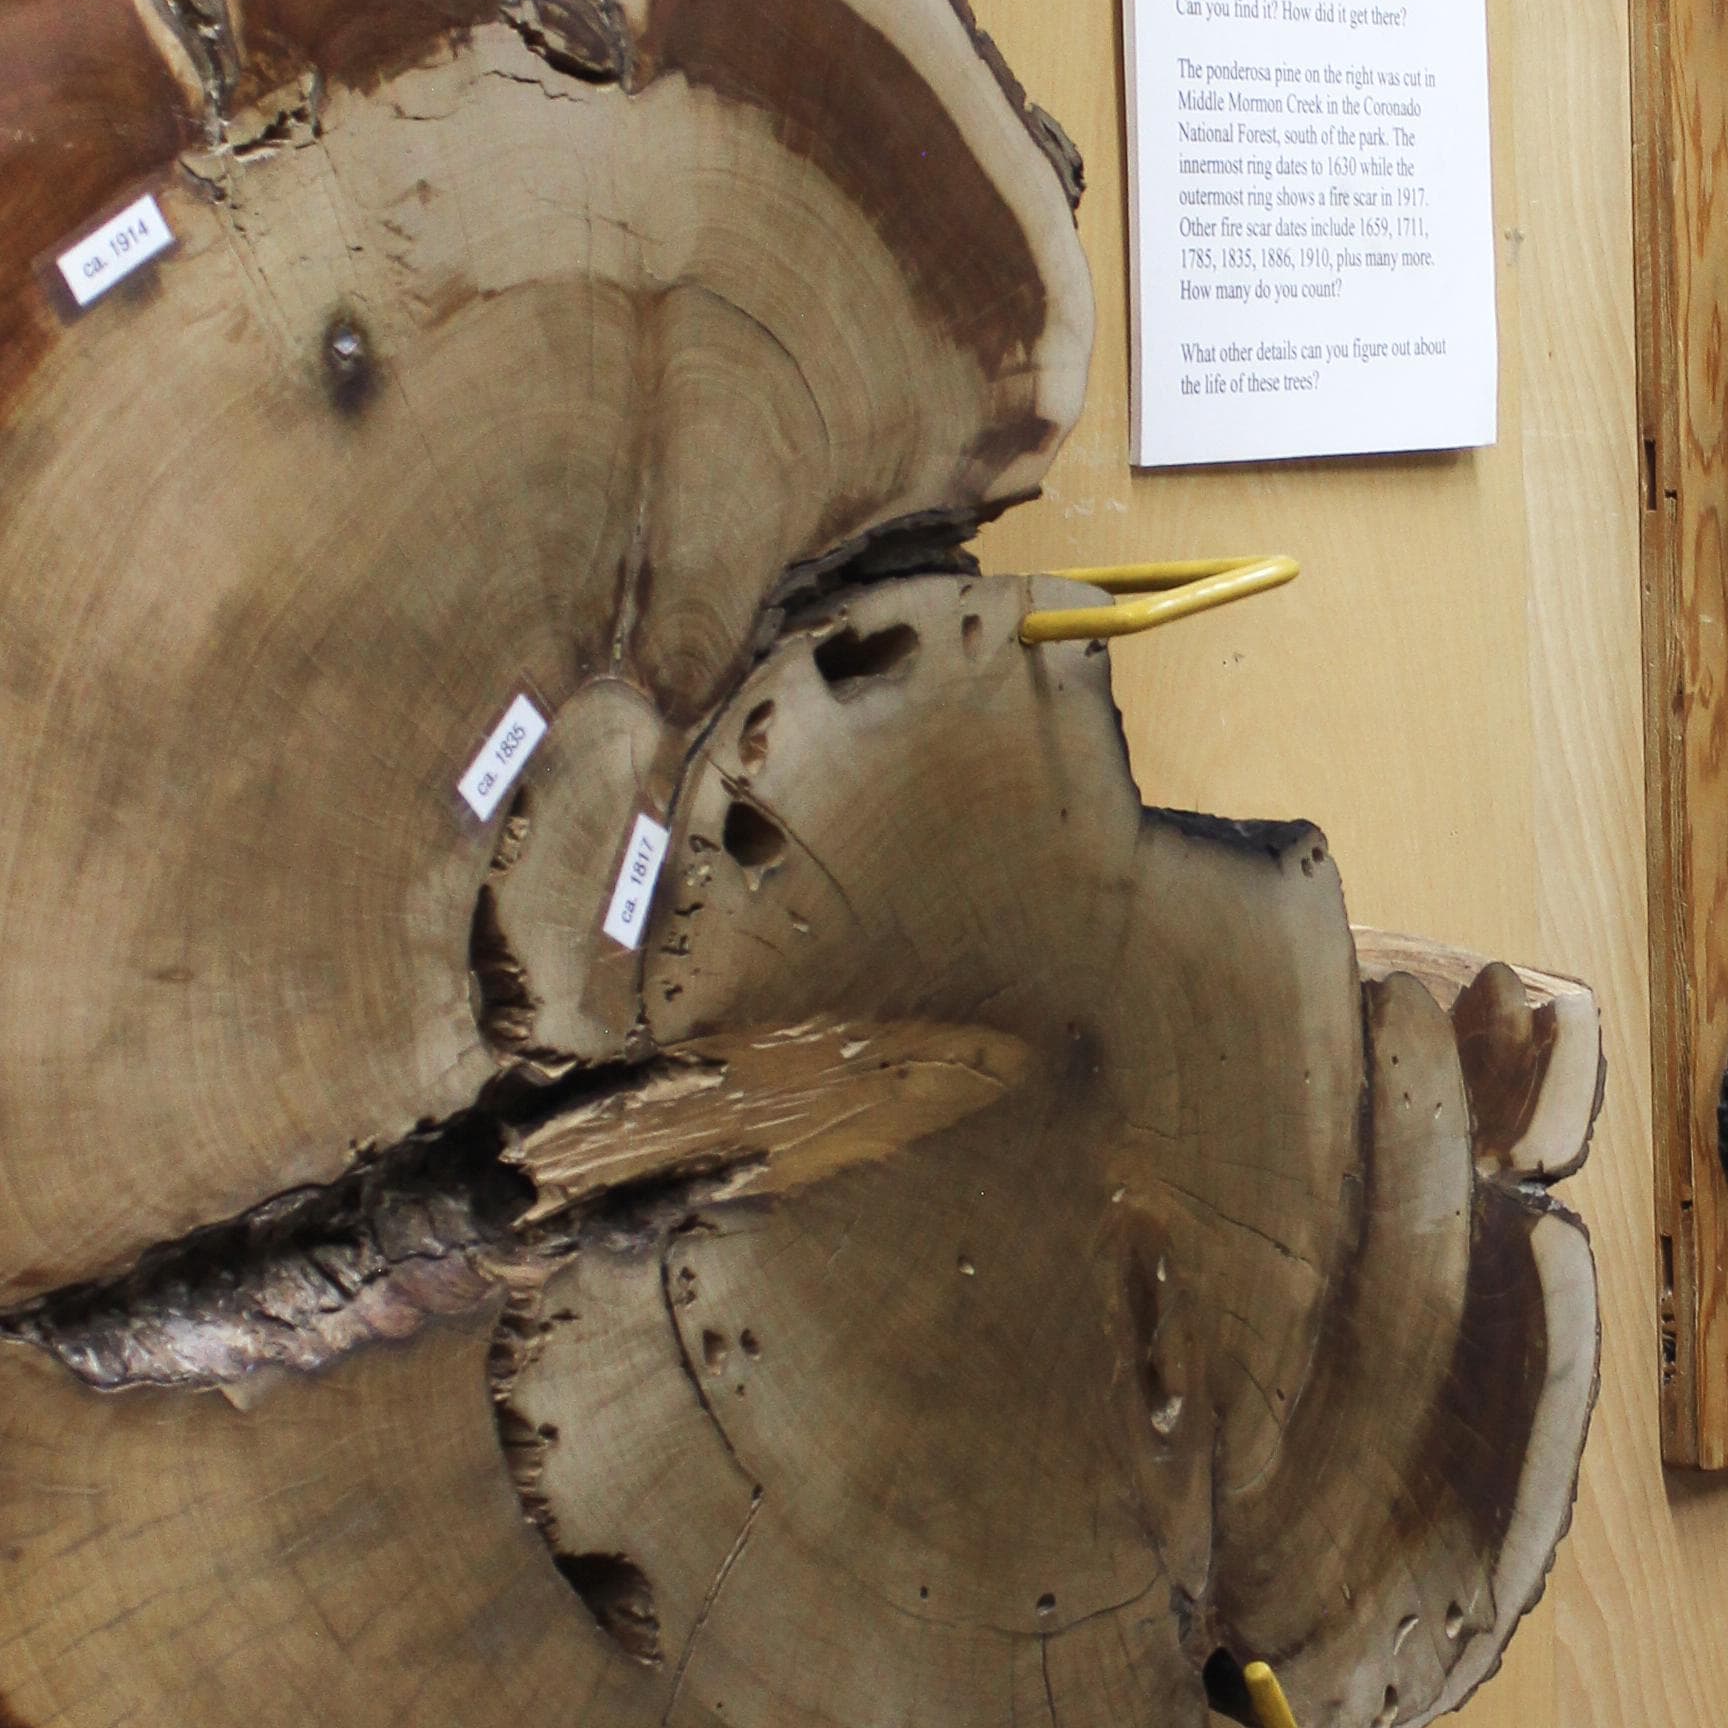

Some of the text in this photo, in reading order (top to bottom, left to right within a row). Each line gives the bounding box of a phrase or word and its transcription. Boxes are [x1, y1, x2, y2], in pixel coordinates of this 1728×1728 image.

[1205, 1, 1230, 21] you
[1281, 0, 1311, 21] How
[1314, 1, 1334, 23] did
[1349, 8, 1368, 29] get
[1371, 5, 1407, 26] there?
[1177, 57, 1421, 90] The ponderosa pine on the right was cut
[1177, 89, 1421, 116] Middle Mormon Creek the Coronado
[1177, 121, 1234, 143] National
[1284, 124, 1318, 145] south
[1337, 125, 1356, 145] the
[1393, 126, 1415, 147] The
[1179, 152, 1414, 180] innermost ring dates 1630 while the
[1179, 187, 1244, 206] outermost
[1247, 184, 1273, 211] ring
[1276, 185, 1315, 206] shows
[1329, 185, 1350, 207] fire
[1353, 192, 1378, 206] scar
[1179, 216, 1218, 237] Other
[1220, 216, 1243, 237] fire
[1246, 222, 1272, 237] scar
[1275, 216, 1307, 237] dates
[1310, 216, 1356, 237] include
[82, 218, 148, 278] ca. 1914
[1336, 247, 1362, 273] plus
[1365, 252, 1398, 271] many
[1180, 277, 1342, 304] How many do you count?
[1180, 336, 1446, 364] What other details can you figure out about
[1180, 370, 1319, 395] the life these trees?
[477, 724, 527, 796] ca. 1835
[621, 837, 655, 924] ca. 1817
